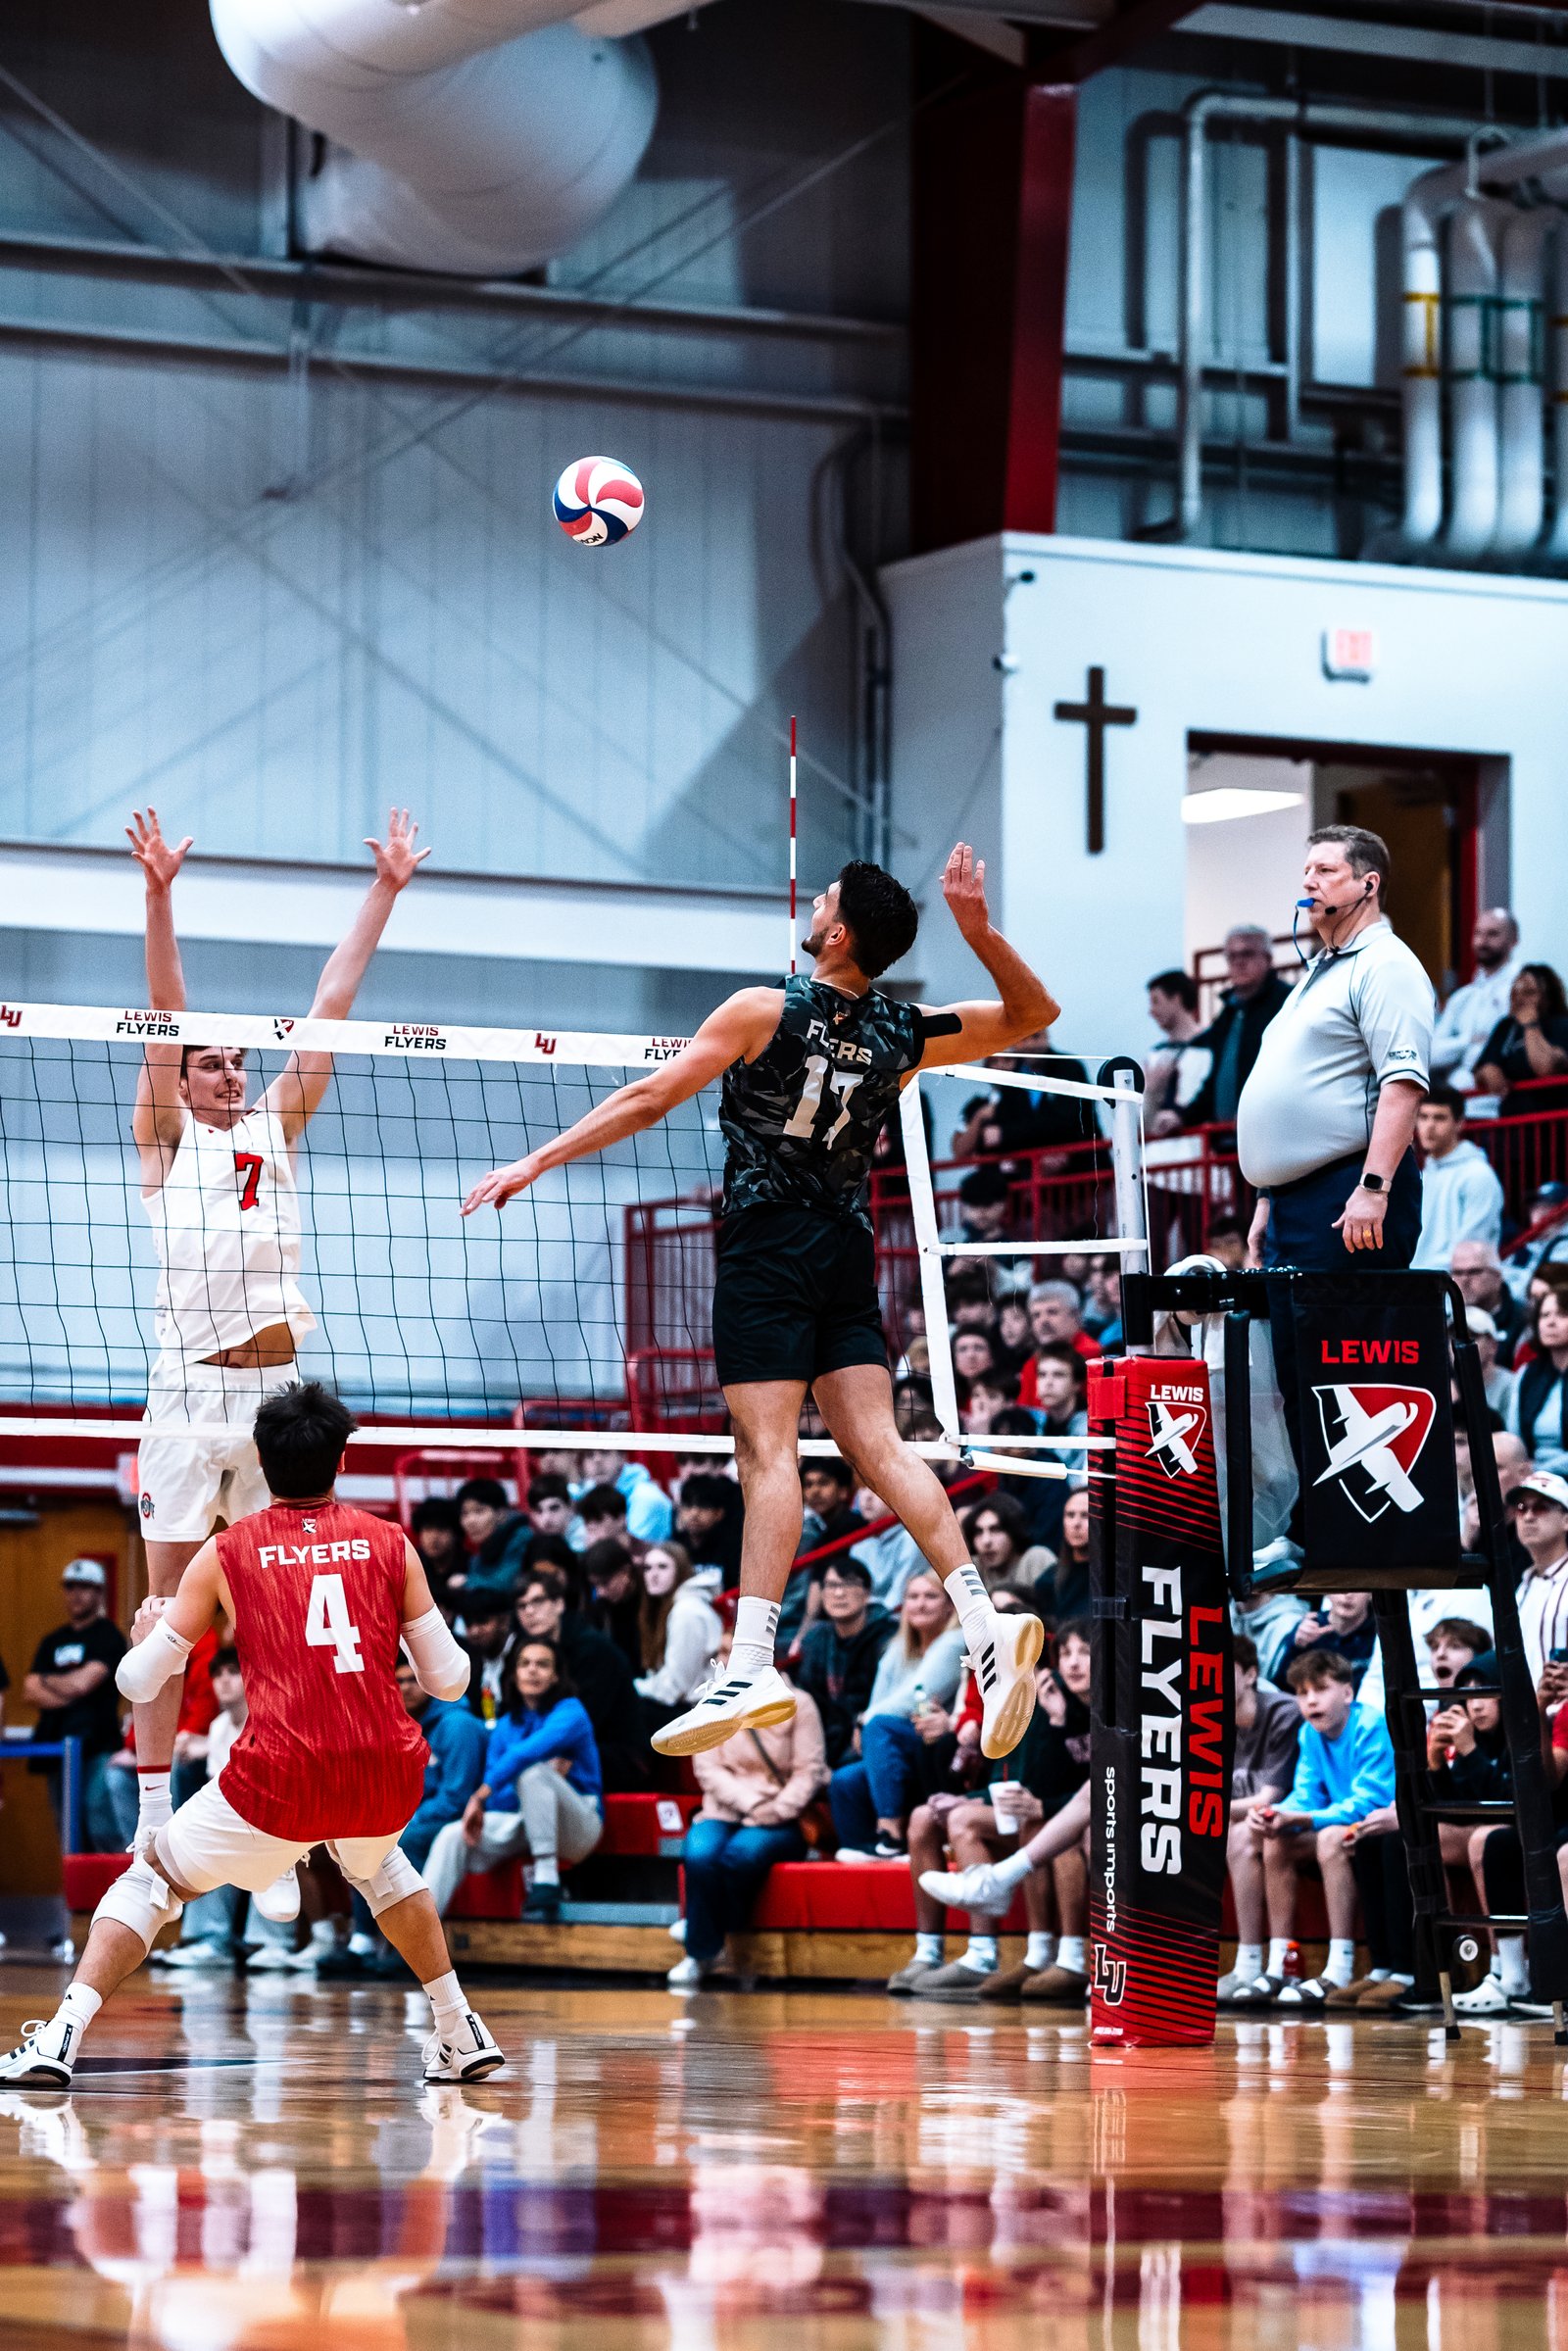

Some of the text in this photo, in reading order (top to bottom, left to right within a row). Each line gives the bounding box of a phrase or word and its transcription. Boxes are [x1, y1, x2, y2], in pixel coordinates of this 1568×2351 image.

[117, 1022, 179, 1037] FLYERS
[124, 1010, 172, 1022] LEWIS
[393, 1025, 439, 1036] LEWIS
[384, 1036, 447, 1051] FLYERS
[652, 1038, 691, 1048] LEWI
[807, 1019, 872, 1065] FLERS
[783, 1054, 864, 1151] 17
[234, 1152, 264, 1210] 7
[1321, 1340, 1419, 1364] LEWIS
[1150, 1384, 1203, 1402] LEWIS
[258, 1539, 371, 1569] FLYERS
[305, 1573, 366, 1674] 4
[1141, 1566, 1182, 1875] FLYERS
[1189, 1605, 1223, 1837] LEWIS
[1104, 1766, 1115, 1933] sports imports
